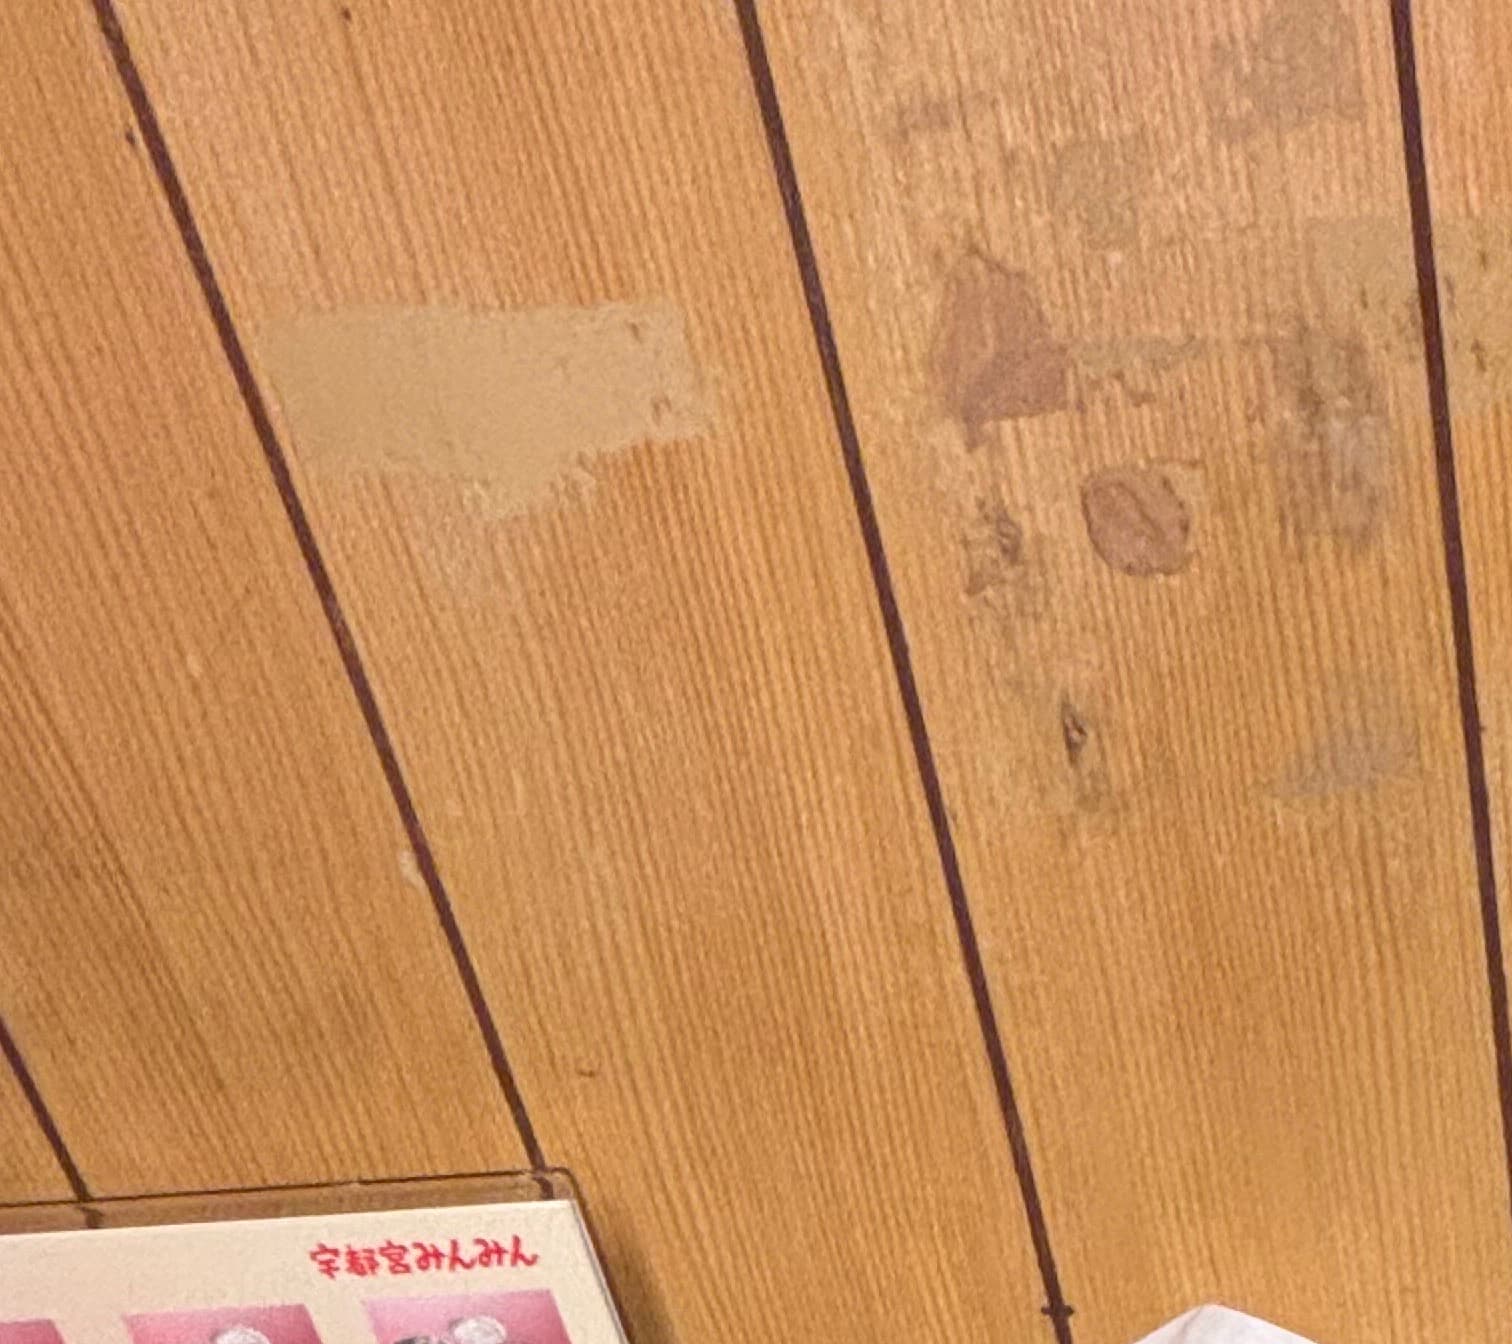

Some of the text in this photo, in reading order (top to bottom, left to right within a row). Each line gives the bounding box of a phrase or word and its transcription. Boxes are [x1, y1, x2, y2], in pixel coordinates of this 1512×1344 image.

[308, 1234, 539, 1280] 宇都宮みんみん
